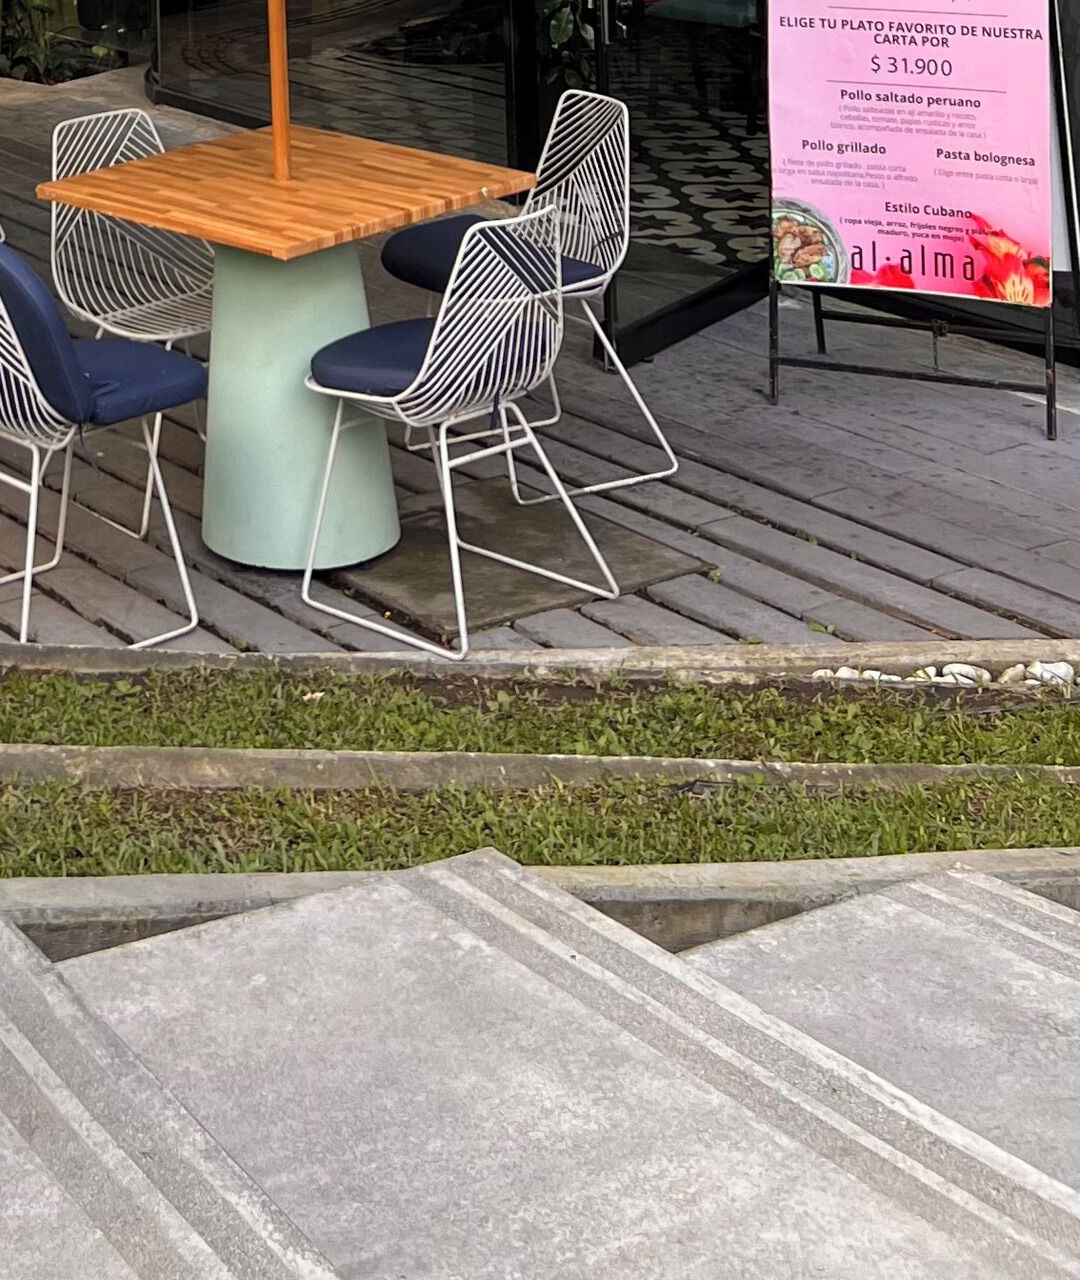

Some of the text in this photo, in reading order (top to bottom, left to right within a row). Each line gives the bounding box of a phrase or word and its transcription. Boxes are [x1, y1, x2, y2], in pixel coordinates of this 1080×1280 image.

[779, 15, 1044, 41] ELIGE TU PLATO FAVORITO DE NUESTRA
[873, 33, 951, 48] CARTA POR
[840, 89, 982, 108] Pollo saltado peruano
[801, 139, 887, 155] Pollo grillado
[936, 148, 1036, 167] Pasta bolognesa
[884, 201, 972, 219] Estilo Cubano
